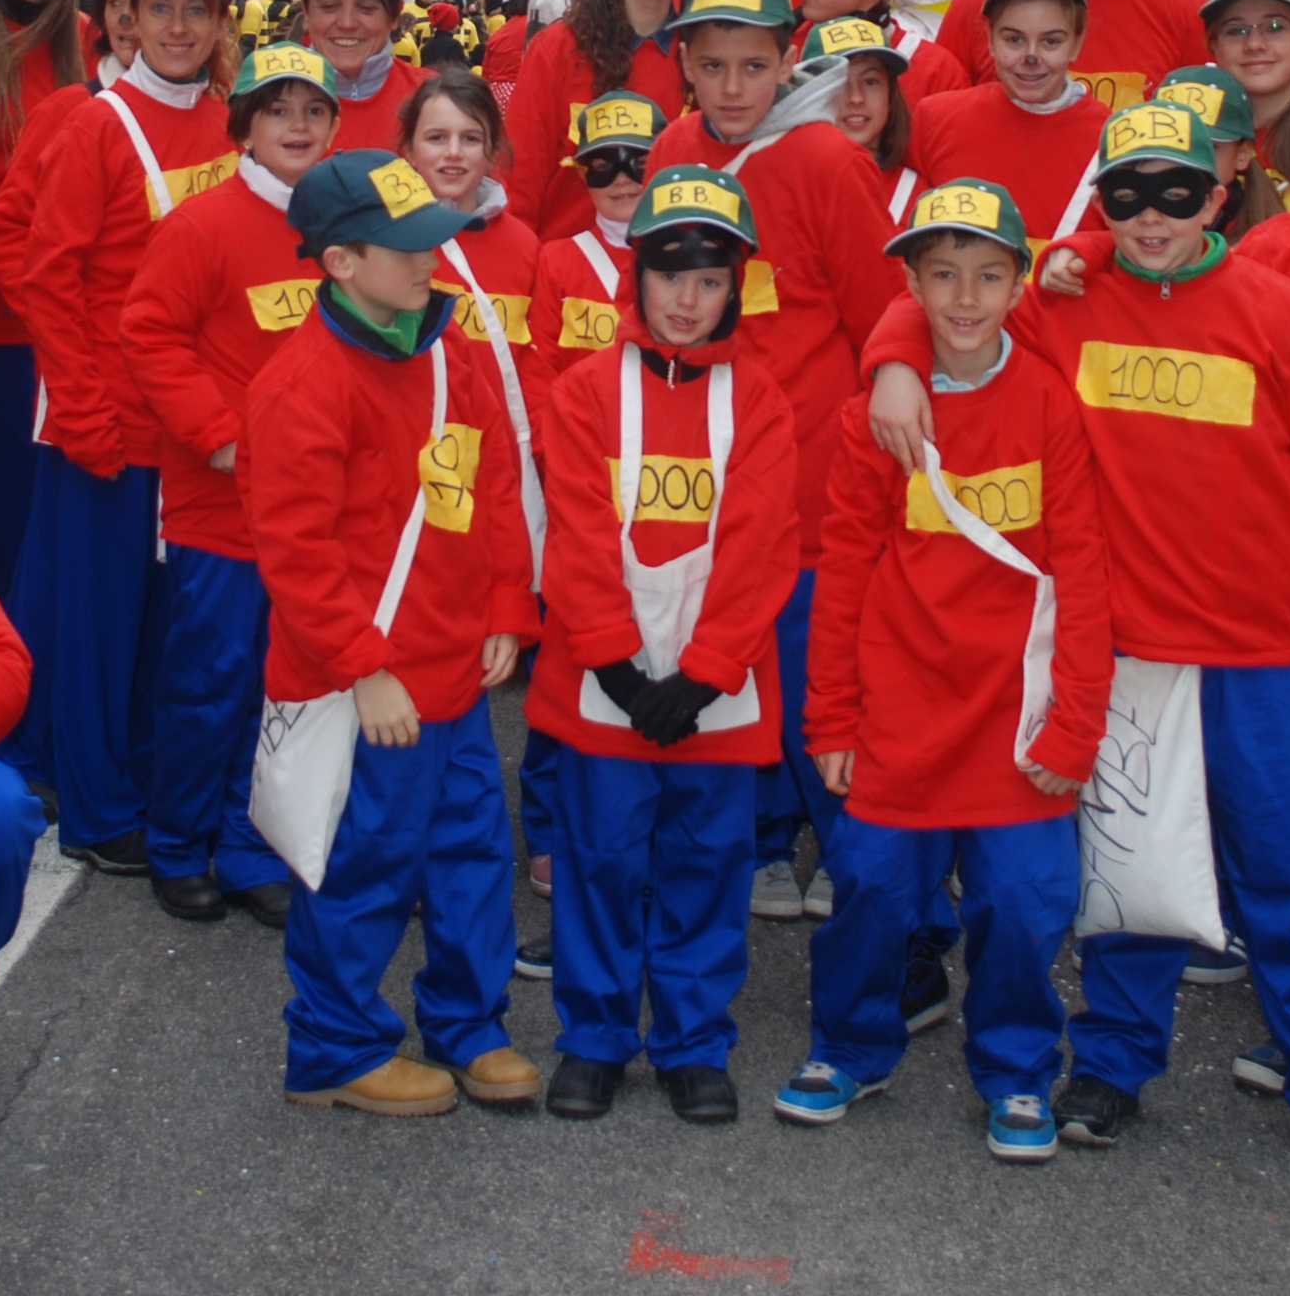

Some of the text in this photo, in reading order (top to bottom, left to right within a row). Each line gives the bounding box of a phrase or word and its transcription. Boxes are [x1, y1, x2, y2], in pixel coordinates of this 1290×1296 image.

[265, 50, 313, 74] B.B.
[594, 105, 640, 131] B.B.
[1107, 110, 1185, 153] B.B.
[668, 184, 713, 206] B.B.
[928, 192, 981, 219] B.B.
[1107, 353, 1205, 408] 1000
